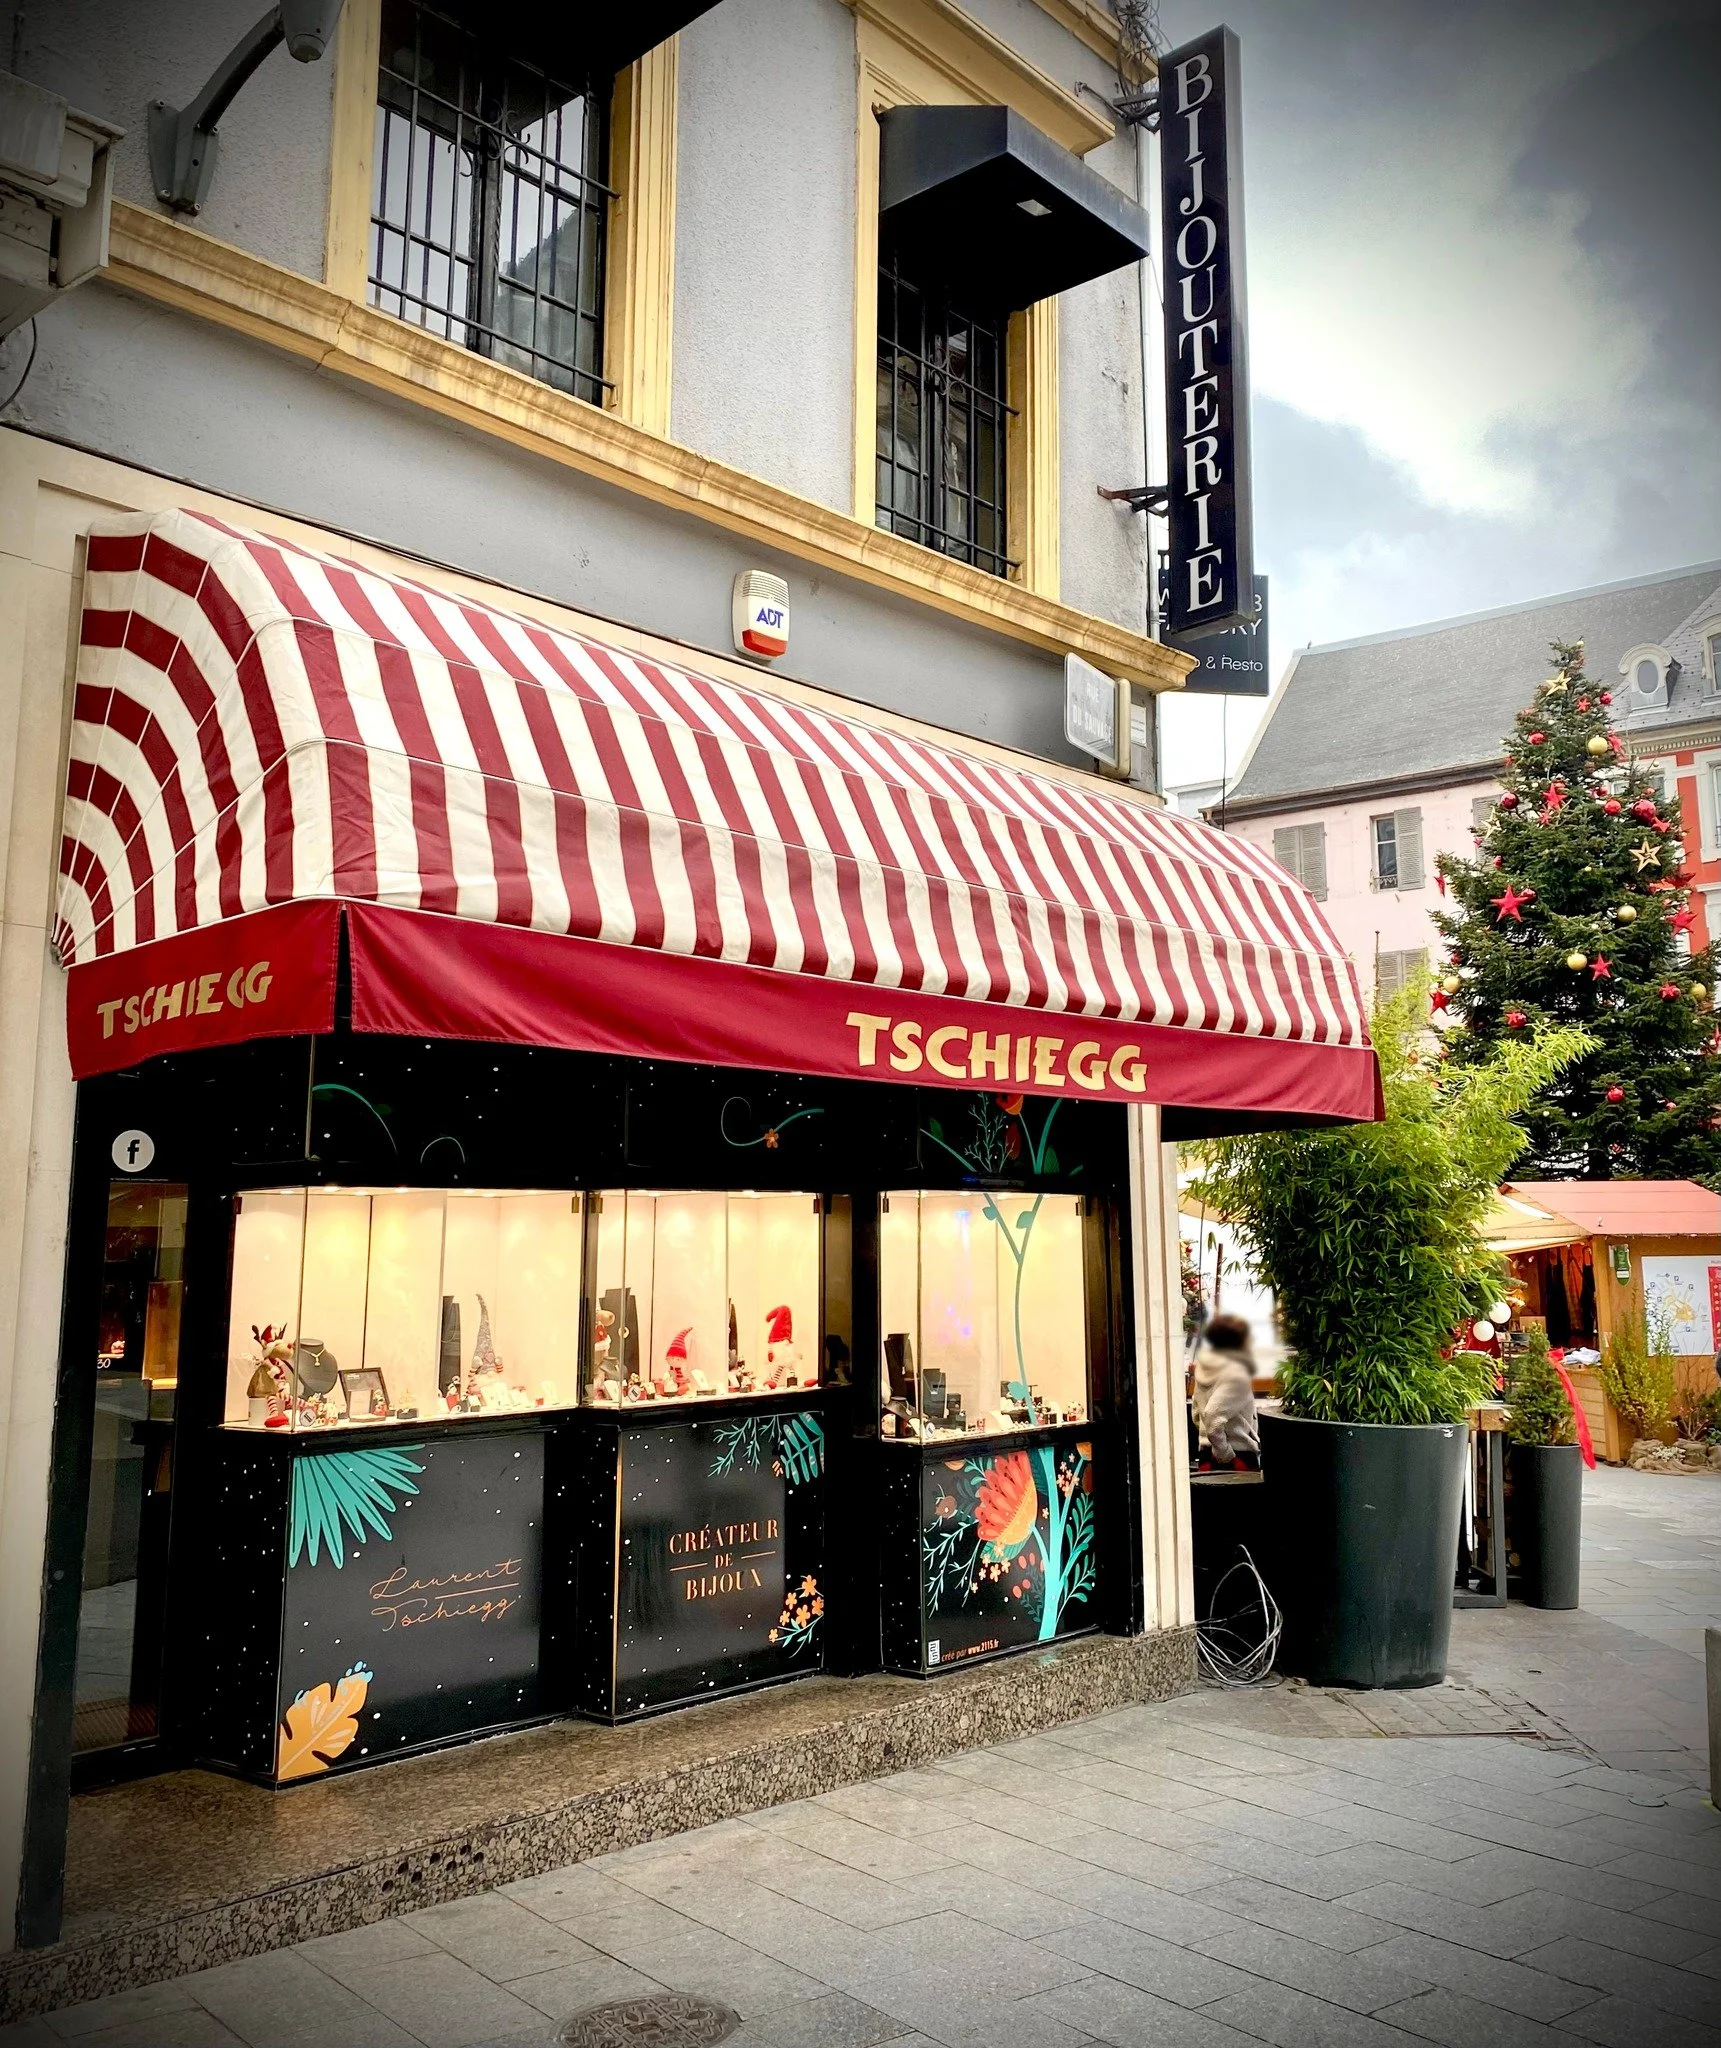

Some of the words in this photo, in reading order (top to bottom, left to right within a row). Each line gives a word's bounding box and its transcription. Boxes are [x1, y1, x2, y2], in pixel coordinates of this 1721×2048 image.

[1174, 52, 1223, 613] BIJOUTERIE
[756, 607, 784, 629] ADT
[1206, 656, 1216, 669] &
[1221, 657, 1263, 672] Resto
[97, 961, 273, 1040] TSCHIEGG
[846, 1011, 1148, 1093] TSCHIEGG
[669, 1519, 779, 1555] CRÉATEUR
[715, 1552, 734, 1569] DE
[369, 1558, 522, 1600] Laurent
[686, 1568, 762, 1601] BIJOUX
[371, 1598, 517, 1632] Tschiegg
